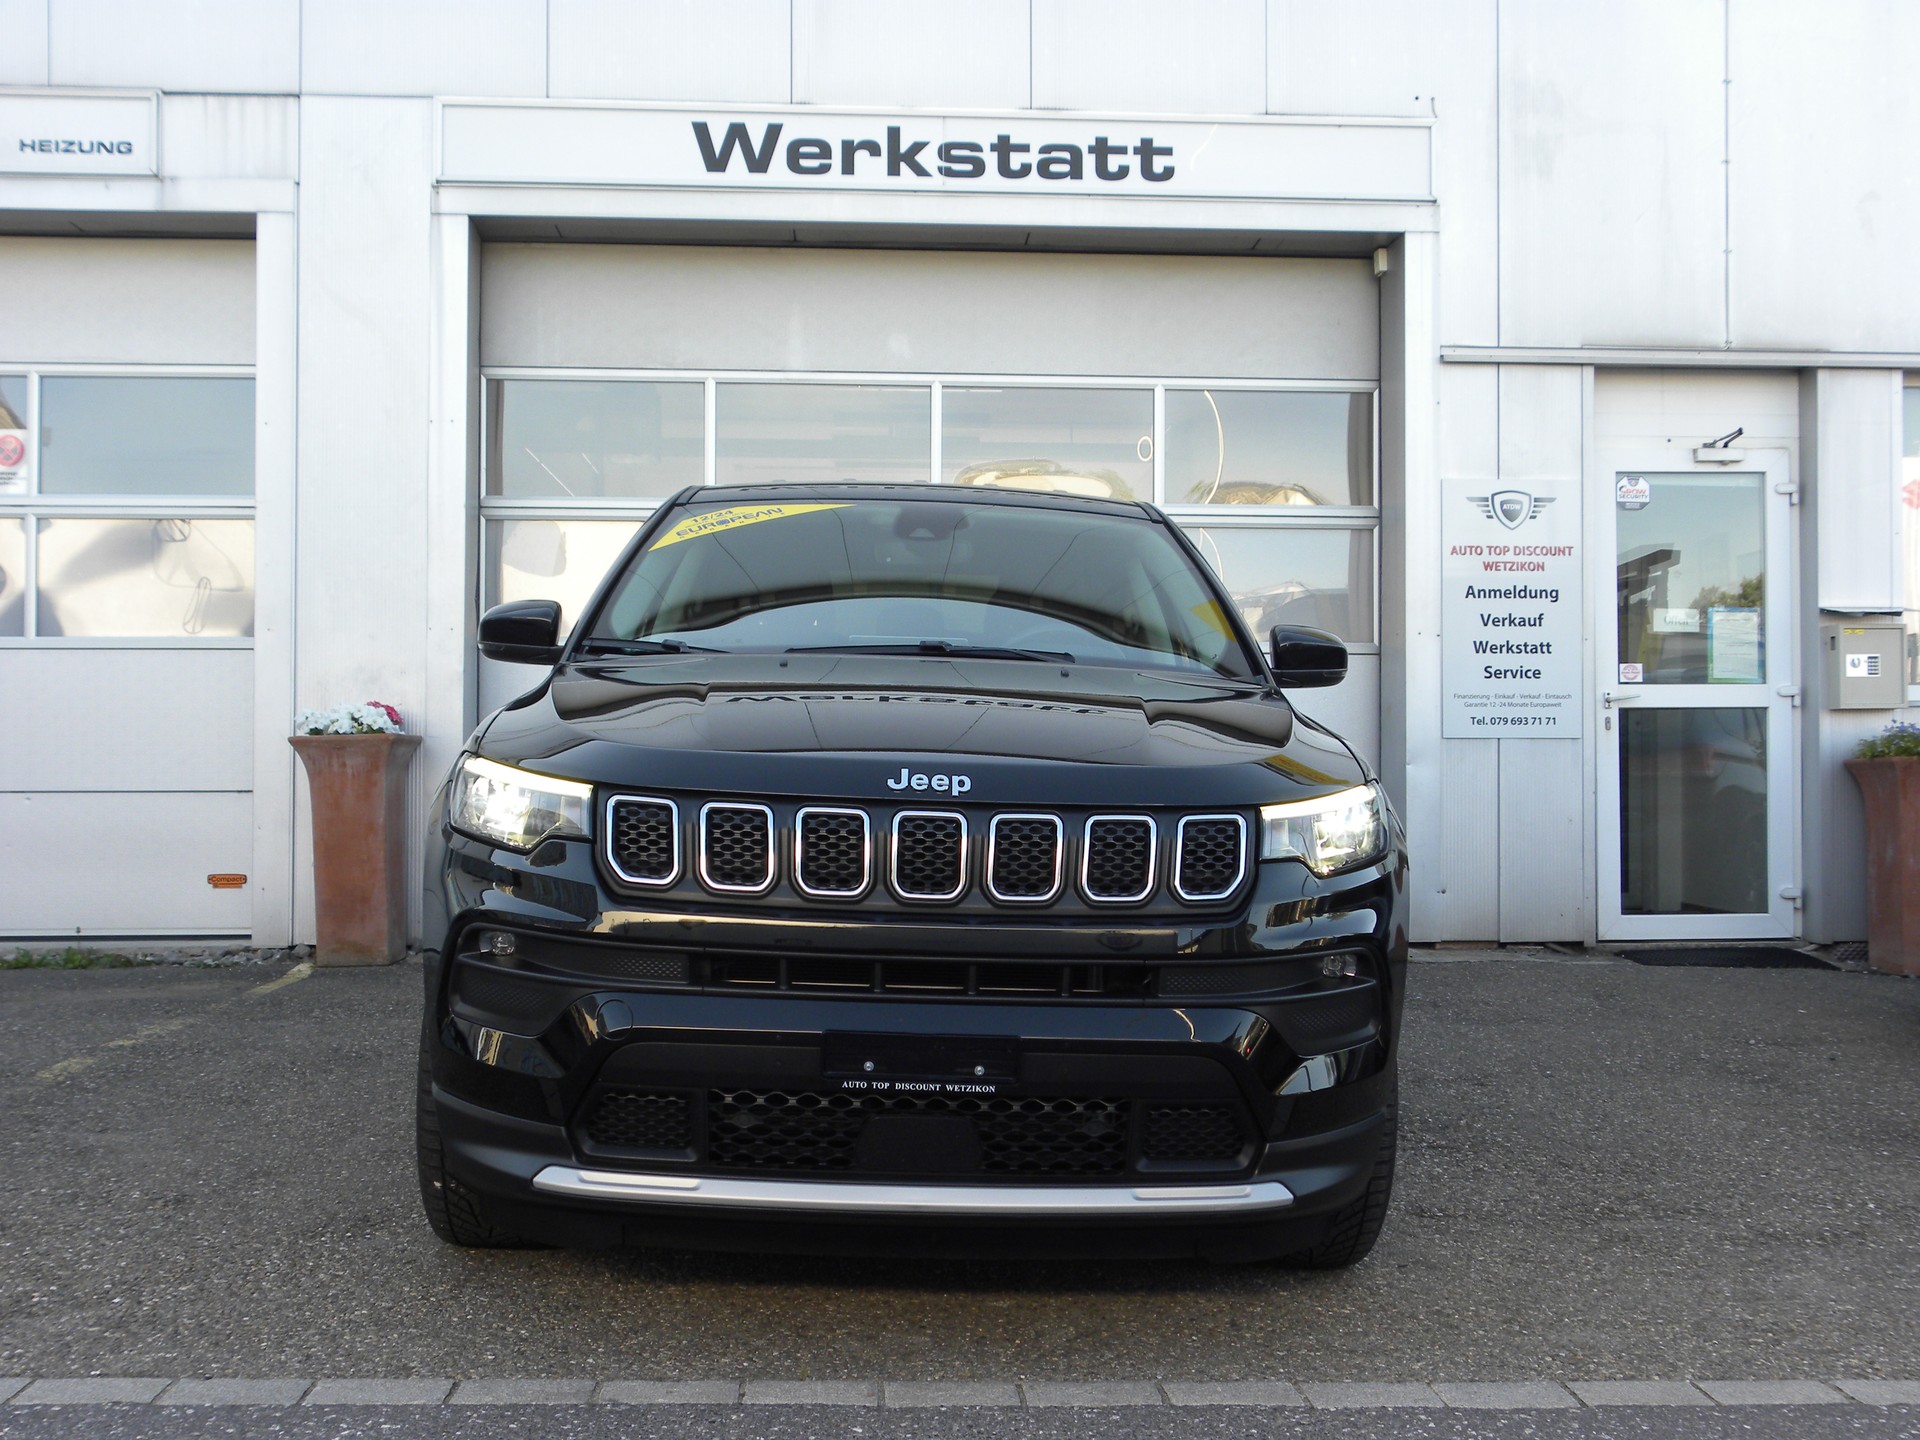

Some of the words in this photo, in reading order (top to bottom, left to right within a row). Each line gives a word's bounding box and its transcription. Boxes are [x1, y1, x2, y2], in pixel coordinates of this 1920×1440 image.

[19, 139, 133, 154] HEIZUNG
[691, 121, 1175, 182] Werkstatt
[1502, 503, 1521, 511] ATDW
[675, 507, 783, 536] EUROPEAN
[692, 510, 733, 523] 12/24
[1450, 545, 1483, 556] AUTO
[1486, 545, 1510, 556] TOP
[1513, 546, 1574, 556] DISCOUNT
[1482, 561, 1545, 572] WETZIKON
[1465, 585, 1559, 603] Anmeldung
[1480, 613, 1544, 627] Verkauf
[1473, 640, 1552, 654] Werkstatt
[1484, 665, 1542, 679] Service
[1453, 693, 1490, 701] Finanzierung
[1470, 717, 1488, 725] Tel.
[1490, 717, 1508, 725] 079
[1510, 717, 1529, 725] 693
[1531, 717, 1542, 725] 71
[1545, 717, 1557, 725] 71
[887, 768, 972, 796] Jeep
[842, 1081, 867, 1089] AUTO
[872, 1082, 890, 1090] TOP
[895, 1083, 942, 1091] DISCOUNT
[946, 1084, 996, 1093] WETZIKON
